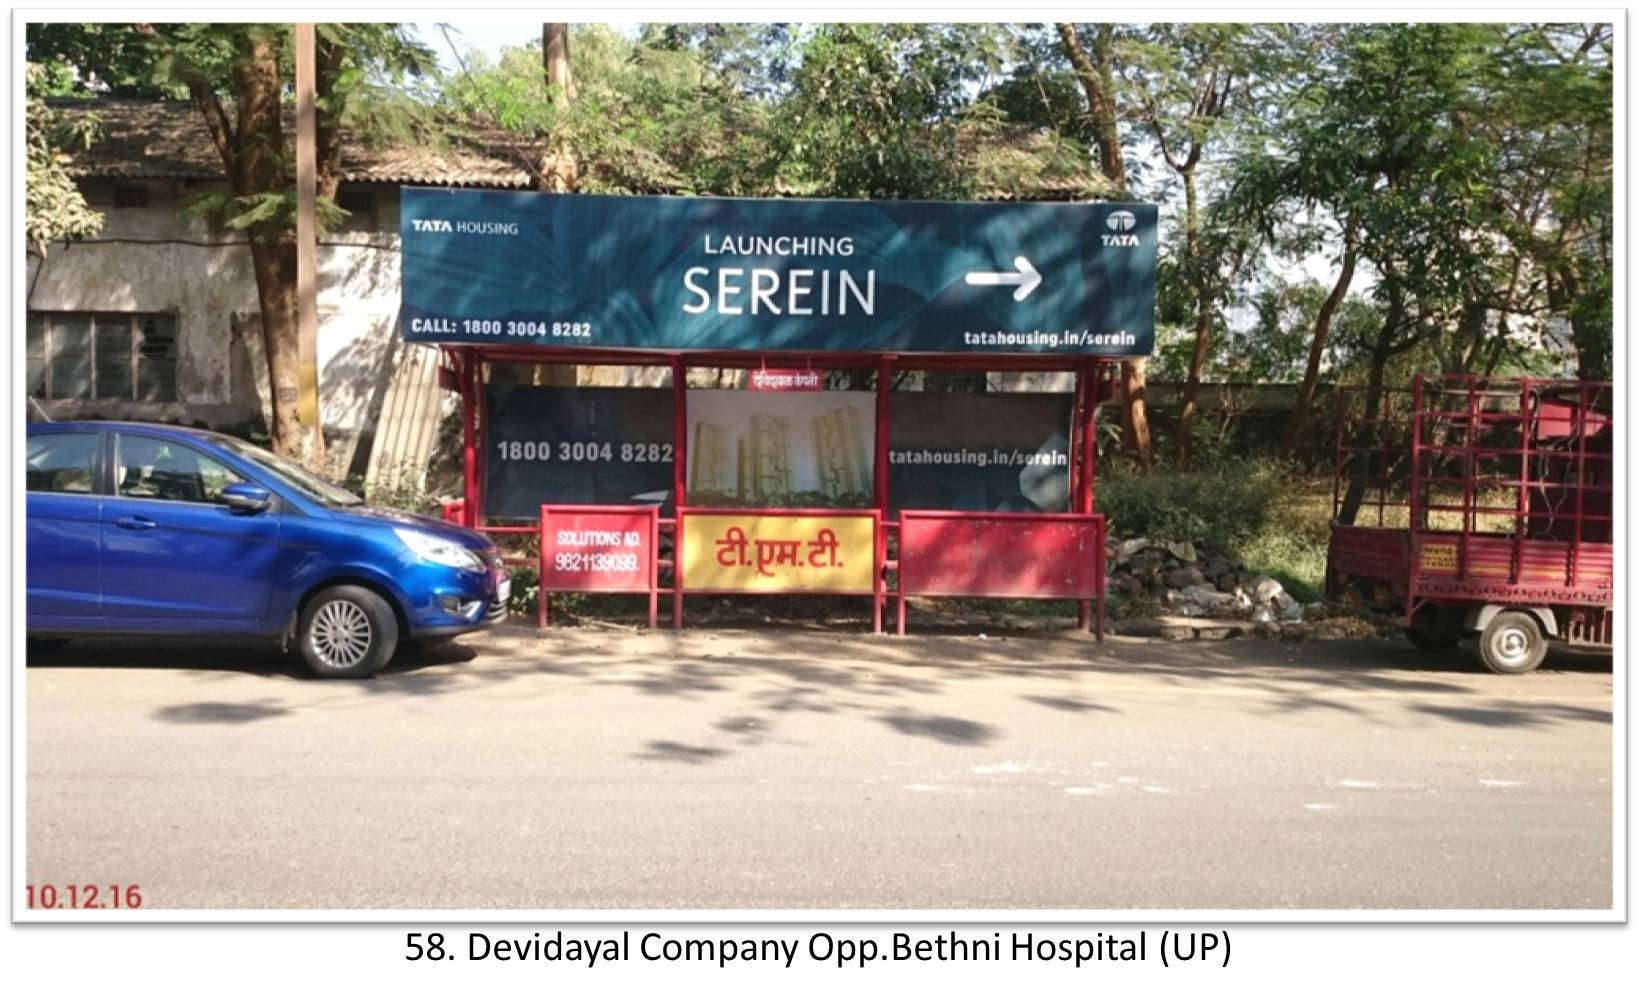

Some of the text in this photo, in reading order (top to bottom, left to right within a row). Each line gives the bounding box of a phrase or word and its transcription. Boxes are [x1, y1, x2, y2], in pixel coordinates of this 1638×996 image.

[411, 219, 519, 236] TATA HOUSING
[704, 234, 854, 257] LAUNCHING
[1101, 234, 1140, 247] TATA
[682, 267, 876, 316] SEREIN
[411, 318, 591, 338] CALL: 1800 3004 8282
[964, 330, 1136, 348] tatahousing.in/serein
[497, 441, 674, 463] 1800 3004 8282
[889, 449, 1068, 467] tatahousing.in/serein
[557, 530, 622, 546] SOLUTIONS
[715, 526, 844, 577] टी.एम.टी.
